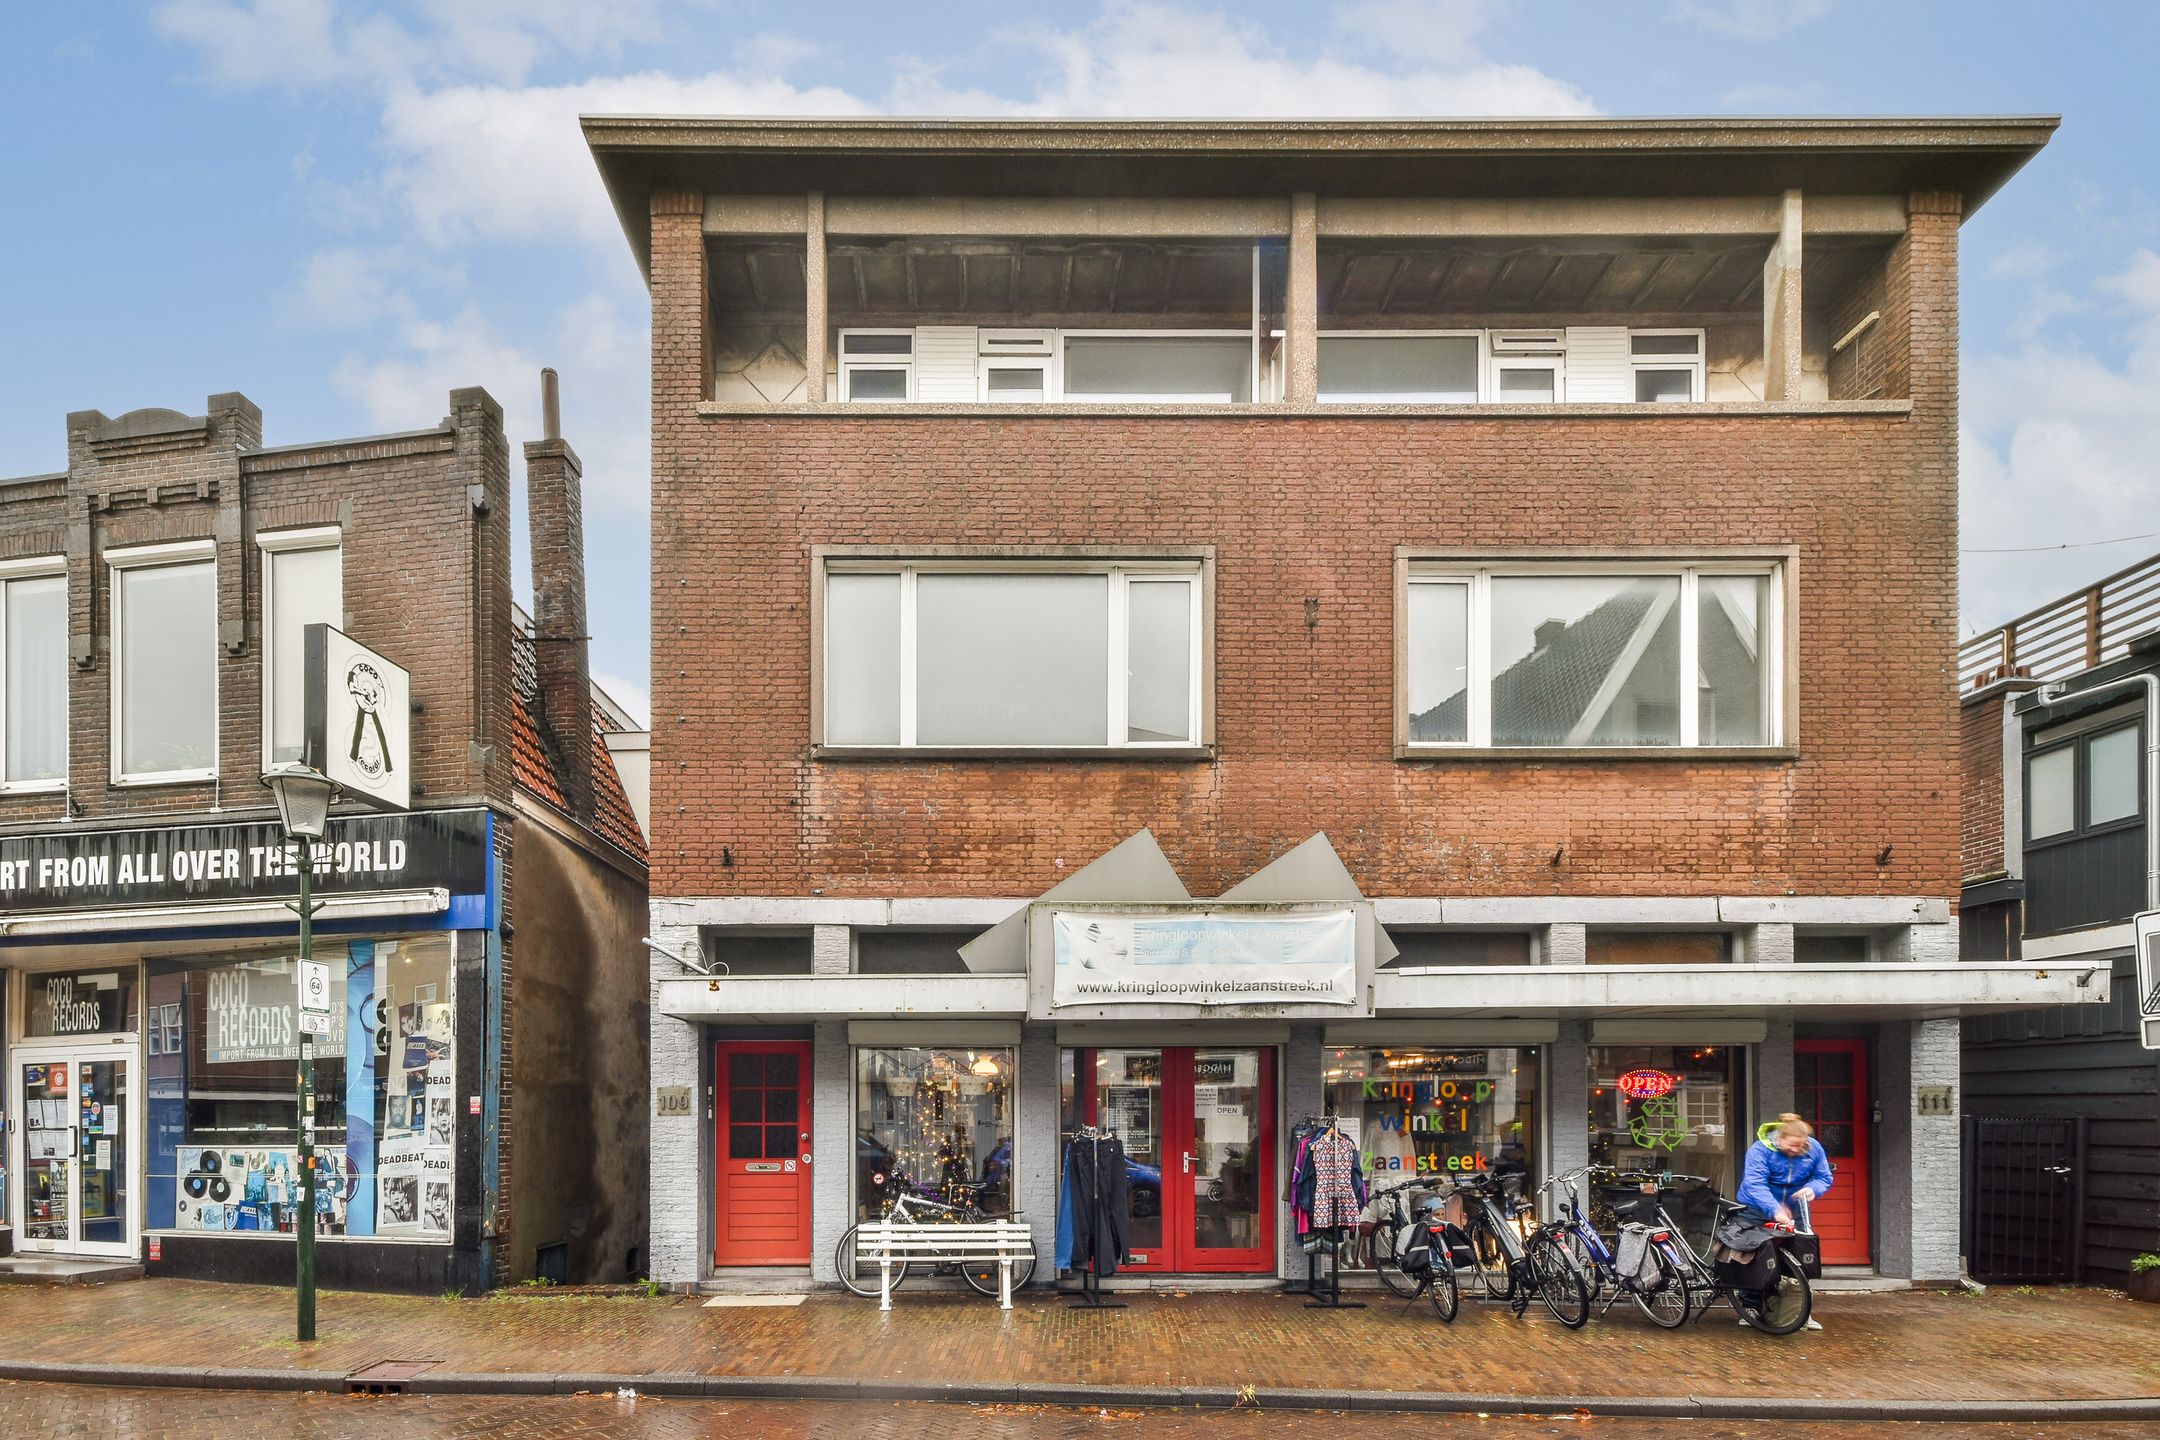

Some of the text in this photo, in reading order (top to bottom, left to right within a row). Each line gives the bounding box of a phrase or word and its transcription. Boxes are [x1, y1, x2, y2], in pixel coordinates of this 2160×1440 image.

[39, 856, 109, 888] FROM
[117, 853, 164, 884] ALL
[172, 848, 240, 882] OVER
[250, 844, 300, 877] THE
[310, 839, 406, 875] WORLD
[47, 976, 73, 1006] COCO
[209, 970, 249, 1011] COCO
[311, 981, 320, 991] 64
[1077, 979, 1334, 996] www.kringloopwinkelzaanstreek.nl
[331, 1001, 344, 1013] D'S
[52, 1001, 100, 1032] RECORDS
[219, 1005, 291, 1048] RECORDS
[220, 1048, 245, 1060] IMPORT
[247, 1047, 266, 1060] FROM
[268, 1047, 280, 1059] ALL
[282, 1046, 300, 1058] OVER
[319, 1045, 344, 1056] WORLD
[427, 1076, 451, 1085] DEAD
[1620, 1077, 1673, 1091] OPEN
[1362, 1075, 1491, 1103] Kinglop
[660, 1095, 689, 1111] 109
[1921, 1094, 1950, 1110] 111
[378, 1152, 425, 1165] DEADBEAT
[1361, 1151, 1488, 1171] Zaansteek
